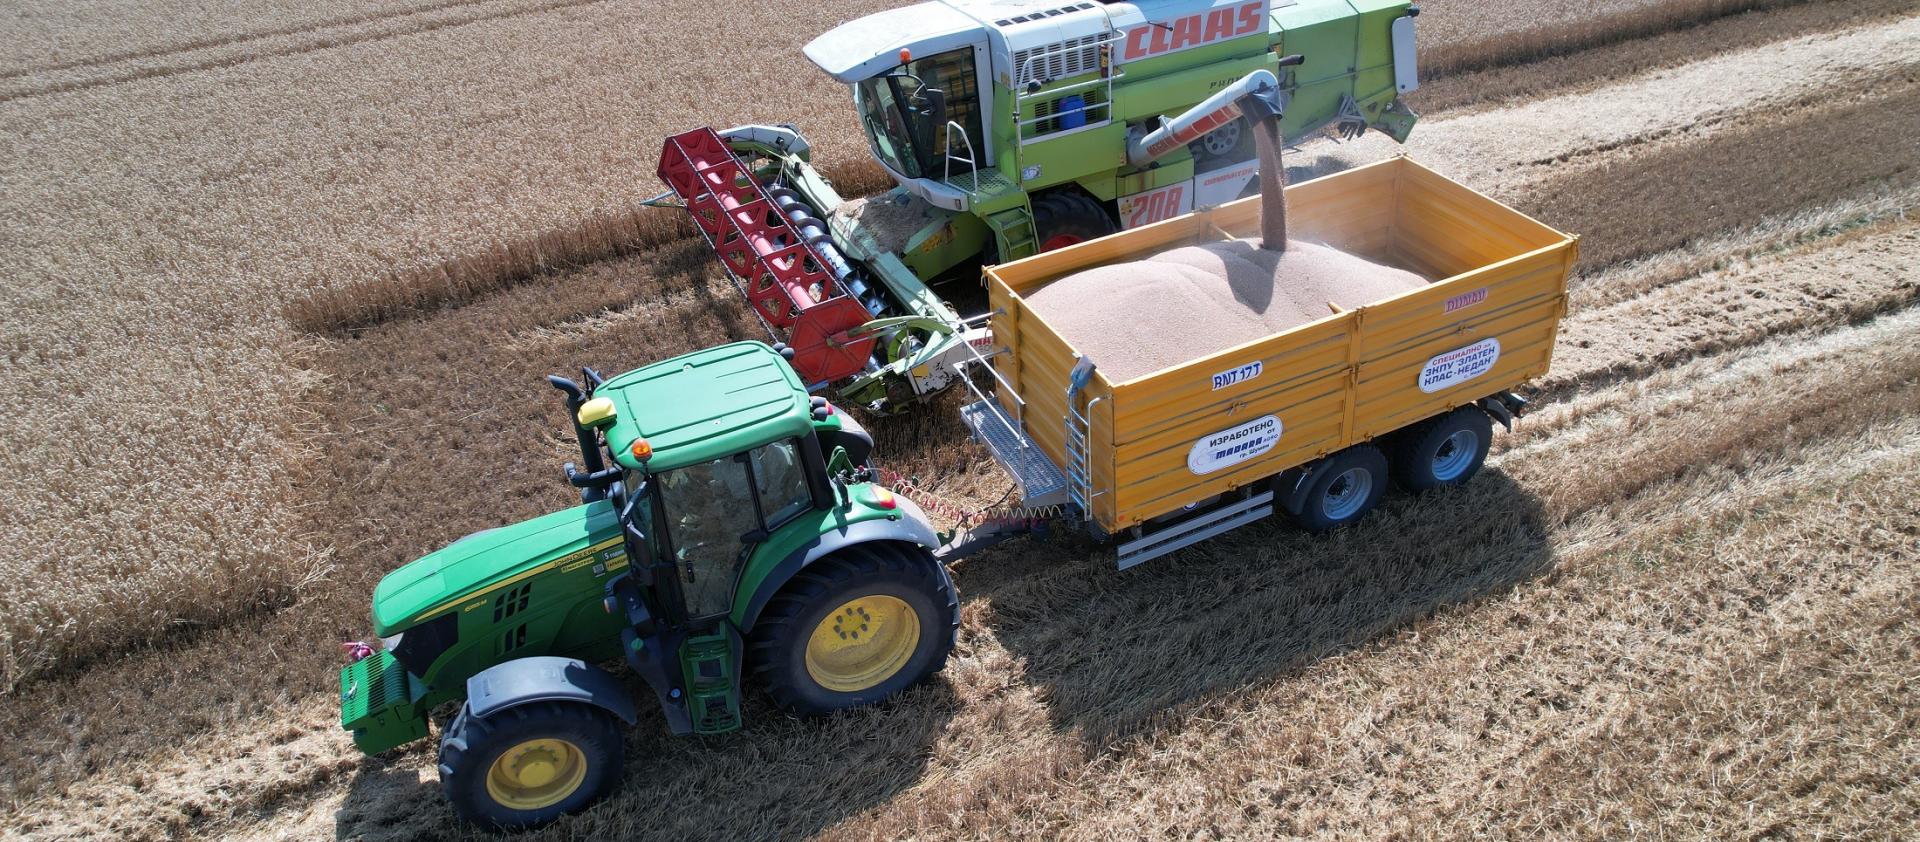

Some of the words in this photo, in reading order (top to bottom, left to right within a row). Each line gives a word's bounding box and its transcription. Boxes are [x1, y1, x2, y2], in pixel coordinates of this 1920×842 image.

[1124, 2, 1263, 60] CLAAS
[1129, 186, 1184, 229] 208
[1432, 345, 1482, 366] СПЕЦИАЛНО
[1209, 419, 1274, 448] ИЗРАБОТЕНО
[1216, 437, 1263, 459] MADARA
